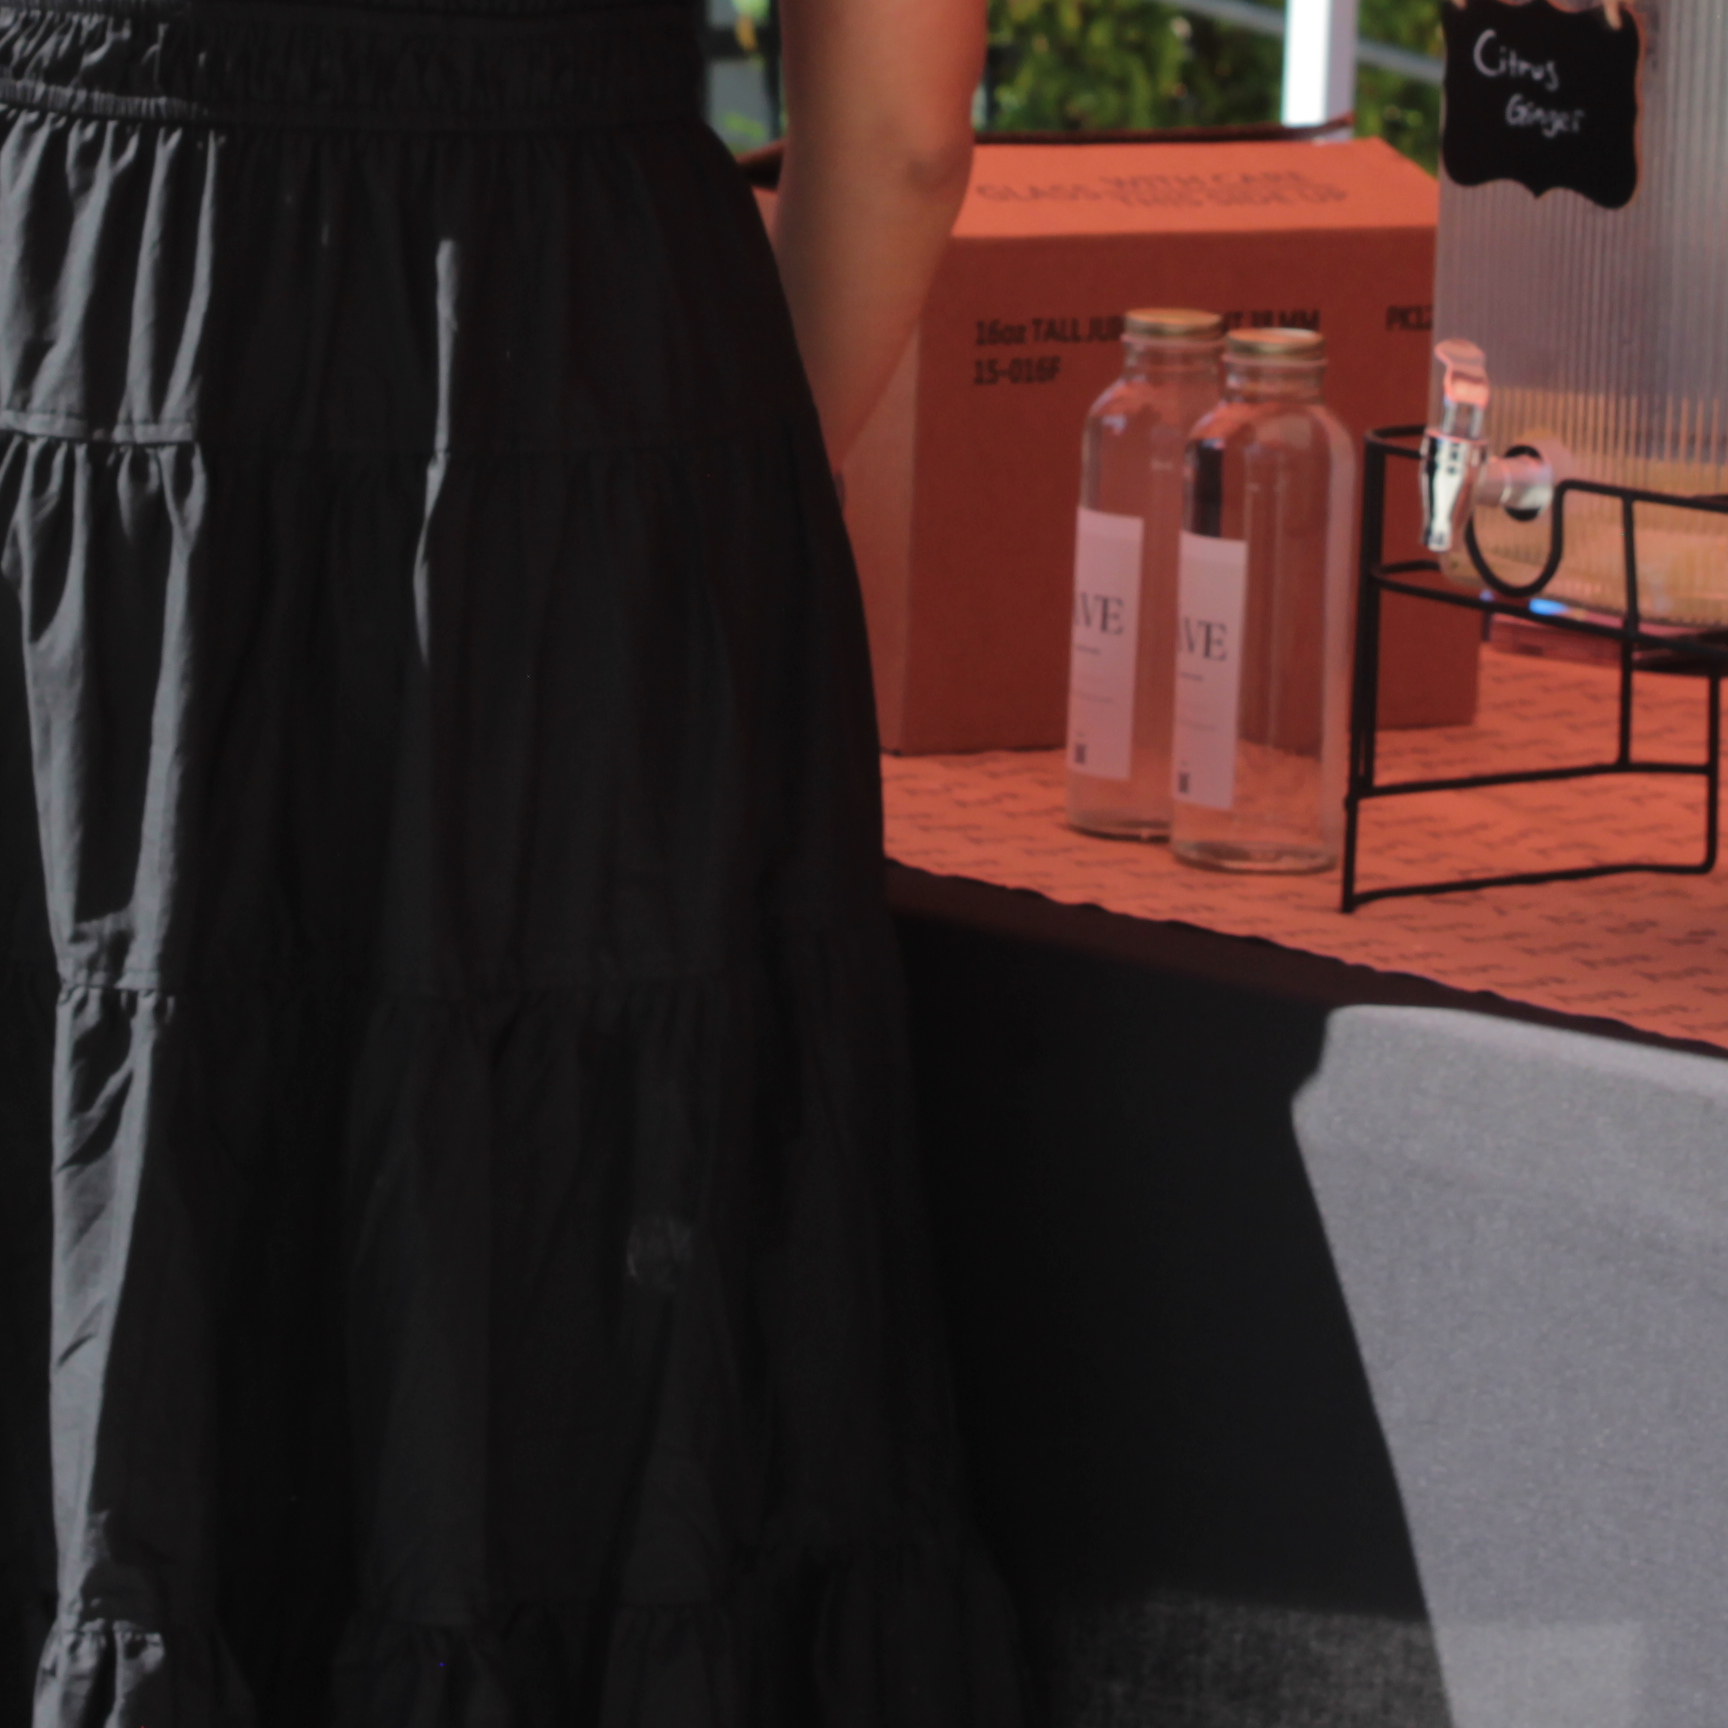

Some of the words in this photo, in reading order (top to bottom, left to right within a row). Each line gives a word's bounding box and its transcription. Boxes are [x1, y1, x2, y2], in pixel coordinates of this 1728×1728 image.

[1473, 28, 1559, 91] Citrus
[1505, 93, 1585, 138] Ginger
[976, 319, 1027, 345] 16oz
[1031, 317, 1081, 343] TALL
[1074, 591, 1125, 635] VE
[1178, 616, 1228, 662] VE
